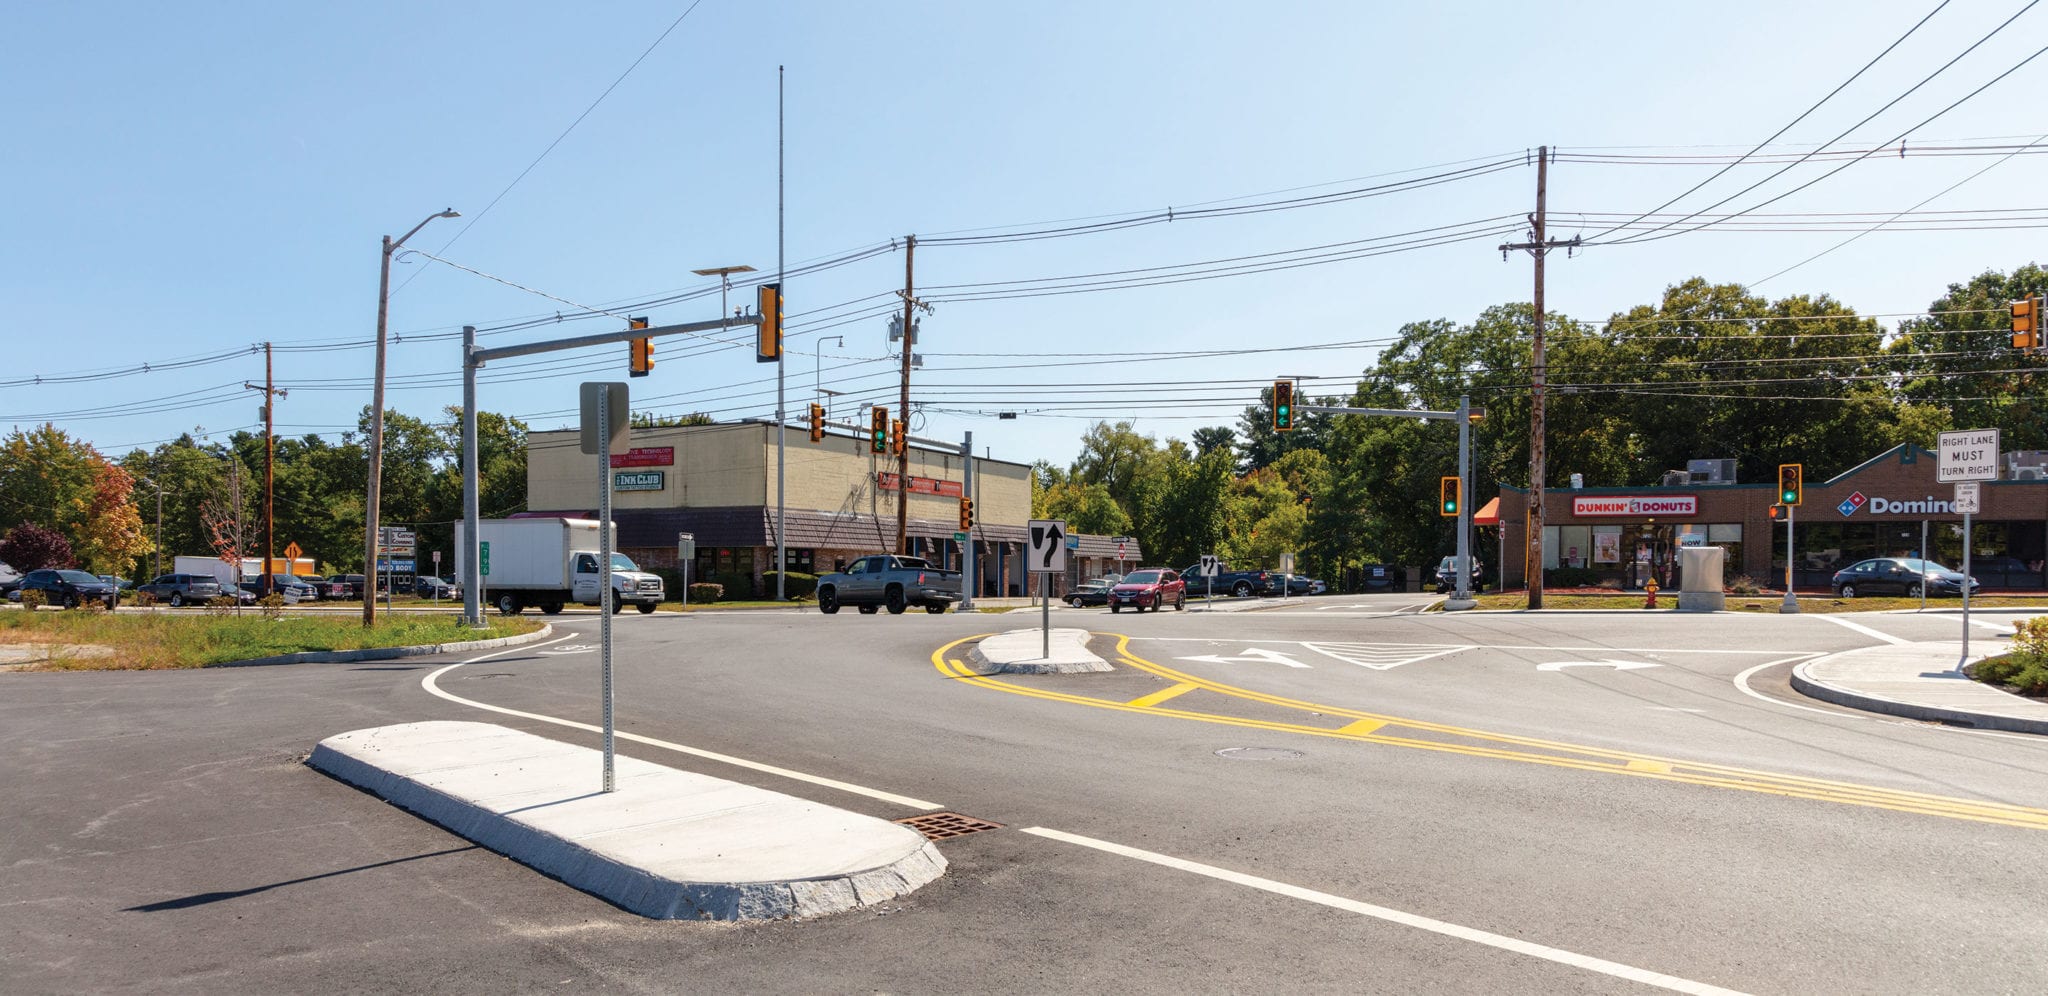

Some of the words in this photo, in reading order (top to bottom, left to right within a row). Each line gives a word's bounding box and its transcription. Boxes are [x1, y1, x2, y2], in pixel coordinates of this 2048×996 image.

[1942, 438, 1968, 447] RIGHT
[1971, 436, 1994, 445] LANE
[1952, 450, 1984, 462] MUST
[1942, 467, 1964, 476] TURN
[1968, 465, 1994, 475] RIGHT
[620, 475, 637, 485] INK
[637, 474, 660, 485] CLUB
[1577, 503, 1628, 513] DUNKIN'
[1642, 502, 1692, 512] DONUTS
